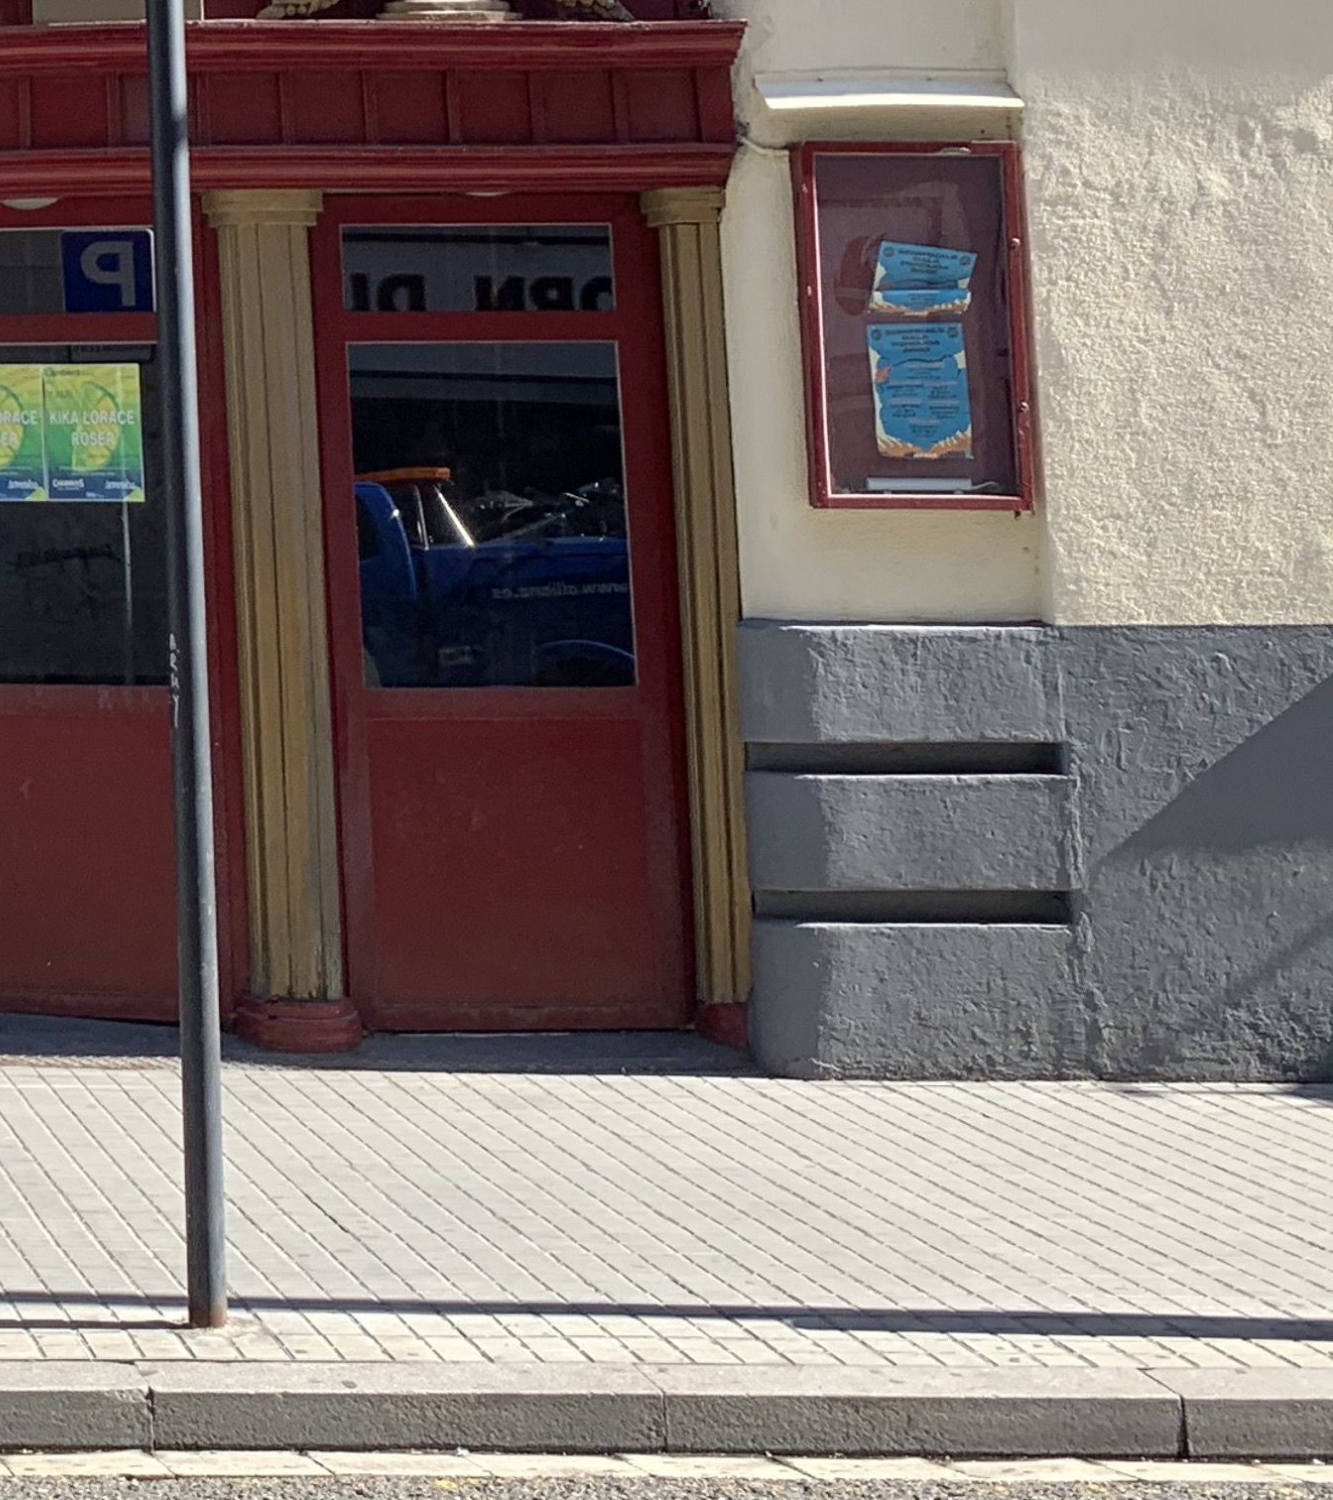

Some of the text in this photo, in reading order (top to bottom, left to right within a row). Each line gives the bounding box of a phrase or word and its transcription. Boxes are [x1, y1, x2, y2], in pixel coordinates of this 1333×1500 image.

[49, 410, 135, 424] KIKA LORACE
[71, 432, 114, 446] ROSER
